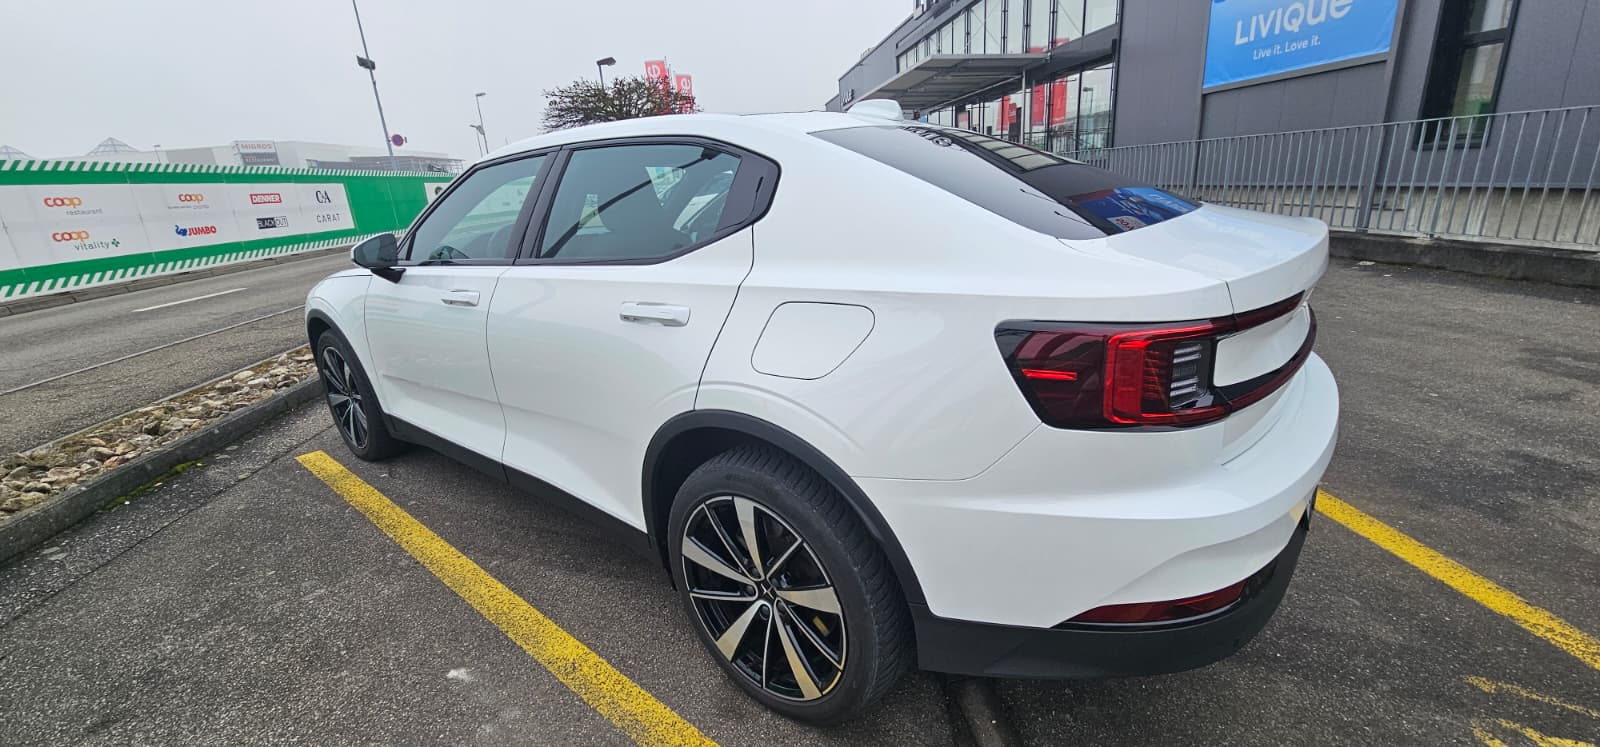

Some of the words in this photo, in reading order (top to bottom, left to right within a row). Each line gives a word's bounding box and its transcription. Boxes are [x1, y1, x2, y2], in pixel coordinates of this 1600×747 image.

[1253, 48, 1272, 60] Live
[1273, 45, 1283, 55] it.
[1285, 40, 1309, 53] Love
[1311, 35, 1321, 46] it.
[43, 197, 82, 208] coop
[179, 193, 204, 204] coop
[251, 194, 281, 203] DENNER
[66, 208, 103, 216] restaurant
[316, 213, 341, 223] CARAT
[52, 230, 90, 242] coop
[188, 225, 217, 236] JUMBO
[74, 241, 110, 251] vitality
